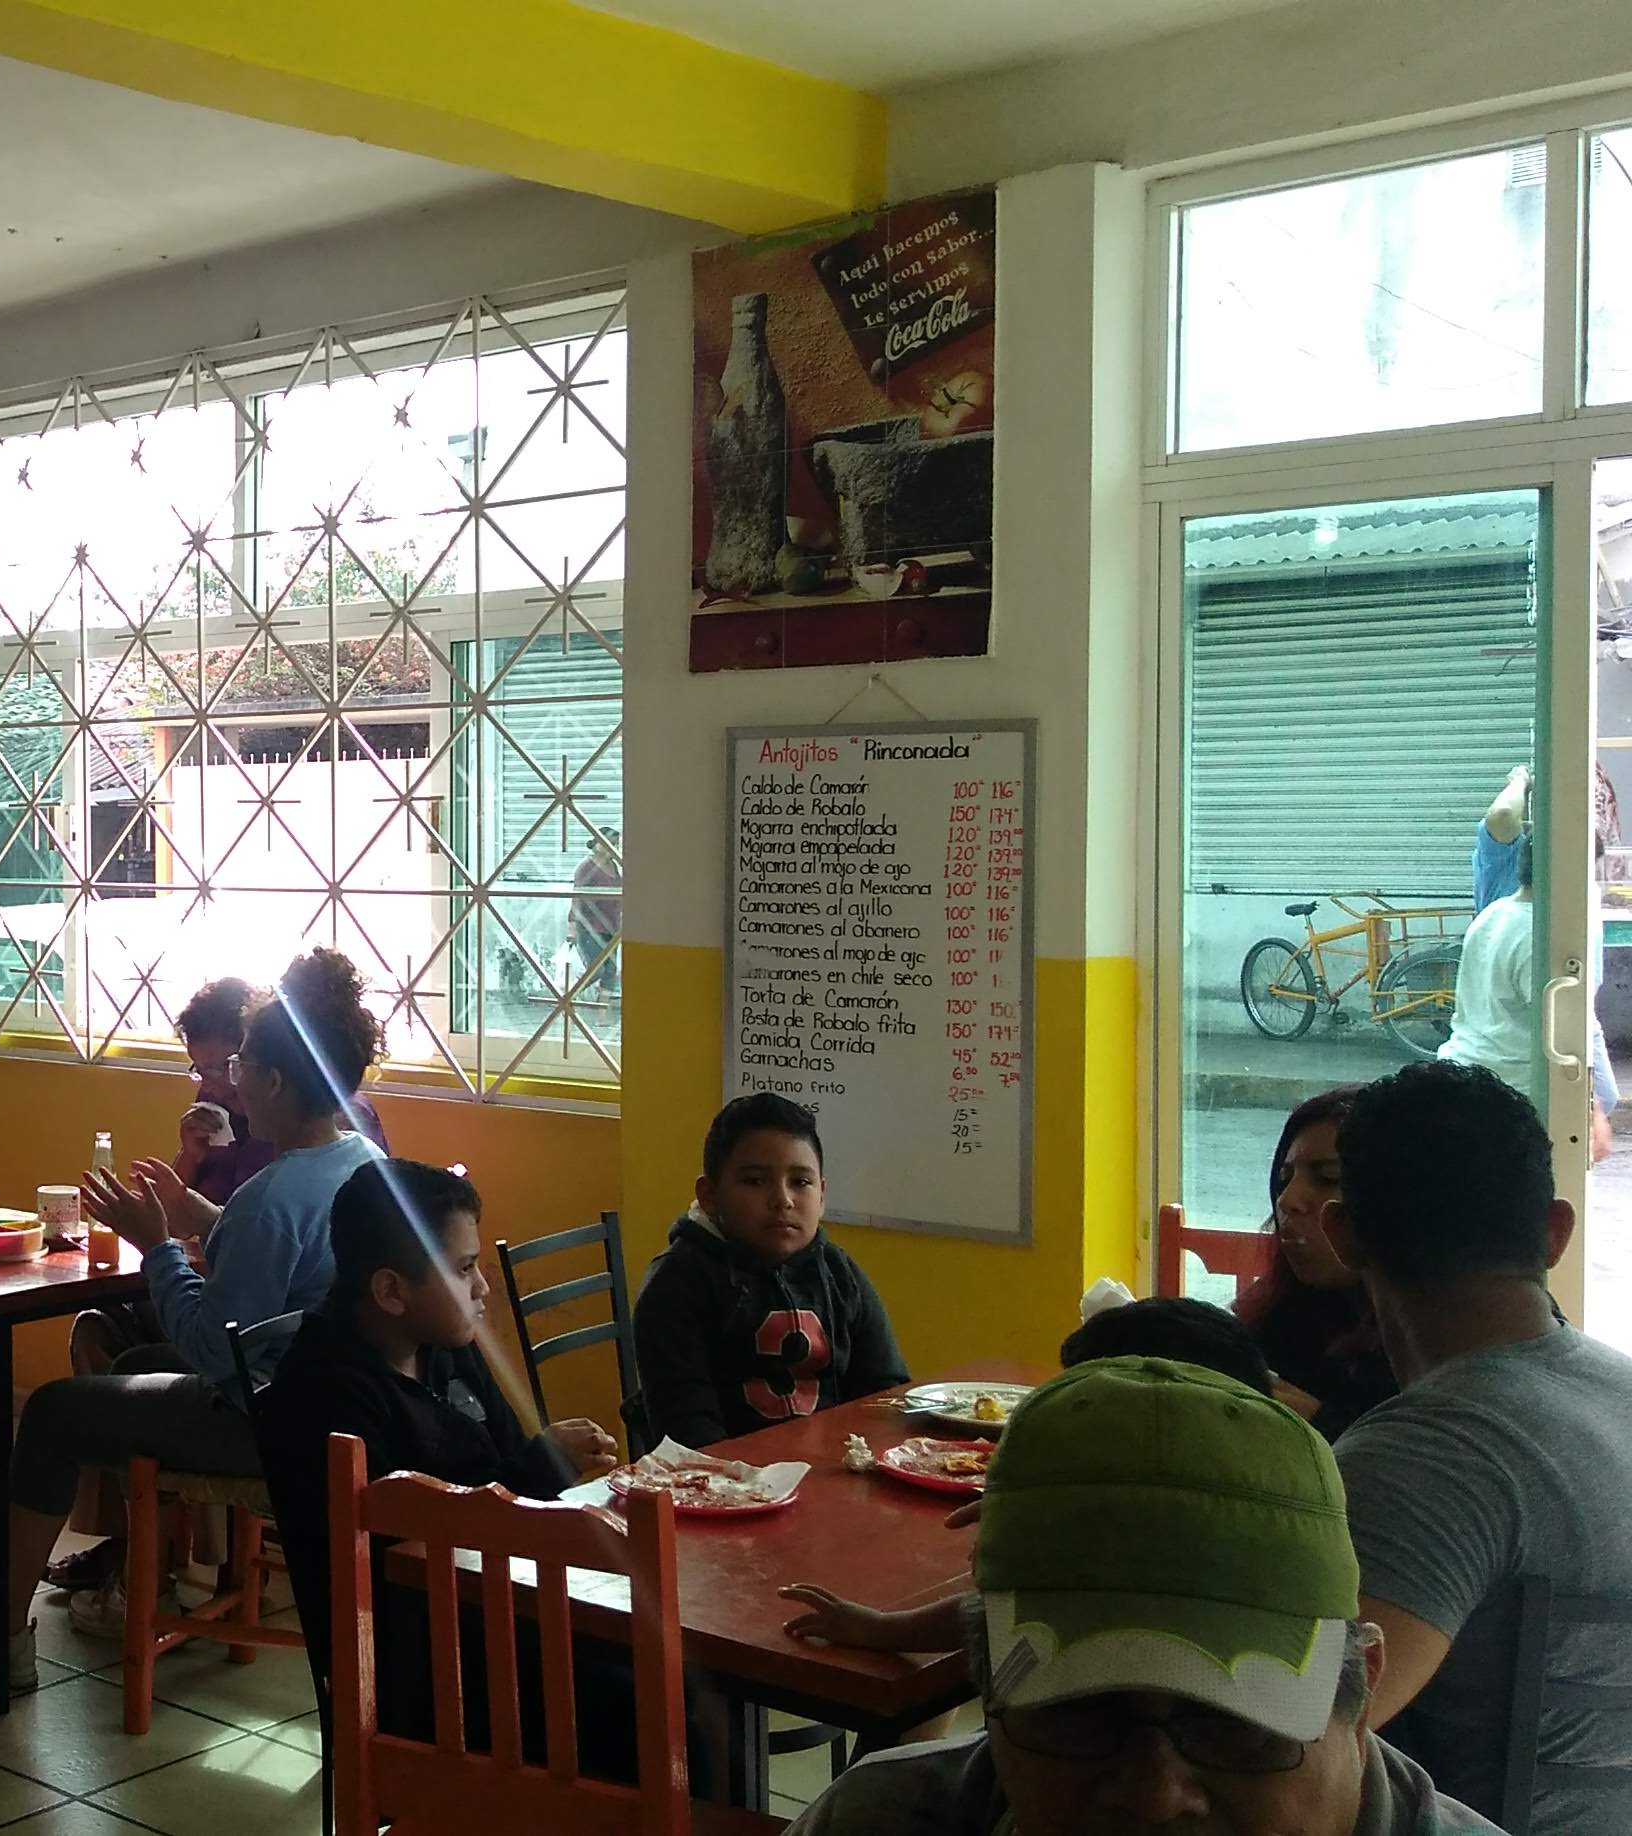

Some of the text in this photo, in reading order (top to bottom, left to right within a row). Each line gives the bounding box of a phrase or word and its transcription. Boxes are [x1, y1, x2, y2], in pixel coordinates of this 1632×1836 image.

[883, 210, 960, 262] hacemos
[850, 279, 888, 310] todo
[893, 261, 925, 285] con
[863, 261, 970, 328] Le servimos
[885, 286, 971, 361] Coca-Cola
[758, 738, 839, 771] Antojitos
[742, 774, 782, 795] Caldo
[784, 773, 804, 795] de
[741, 797, 782, 816] Caldo
[786, 797, 804, 816] de
[811, 796, 866, 816] Robalo
[740, 818, 793, 839] Mojarra
[801, 814, 897, 842] enchipotlada
[740, 836, 795, 858] Mojarra
[801, 837, 896, 861] empapelada
[740, 856, 797, 881] Mojarra
[801, 855, 816, 874] al
[821, 861, 856, 877] mojo
[860, 859, 880, 874] de
[885, 863, 911, 881] ajo
[739, 878, 821, 895] Camarones
[860, 879, 932, 895] Mexicana
[739, 895, 821, 915] Camarones
[826, 897, 842, 916] al
[848, 897, 893, 922] ajillo
[738, 916, 824, 936] Camarones
[831, 918, 846, 937] al
[852, 920, 920, 939] abanero
[741, 939, 820, 960] arones
[823, 940, 838, 961] al
[843, 947, 875, 964] mojo
[877, 944, 896, 962] de
[741, 967, 822, 982] marones
[827, 970, 846, 984] en
[851, 966, 884, 985] chile
[894, 972, 933, 987] seco
[740, 983, 785, 1005] Torta
[792, 986, 816, 1006] de
[825, 988, 899, 1009] Camarón
[741, 1007, 779, 1027] Posta
[784, 1008, 805, 1028] de
[813, 1012, 870, 1032] Robalo
[877, 1012, 916, 1035] frita
[741, 1027, 801, 1049] Comida
[811, 1032, 875, 1055] Corrida
[741, 1048, 835, 1072] Garnachas
[741, 1072, 802, 1092] Platano
[810, 1081, 845, 1094] frito
[743, 1310, 832, 1419] 3
